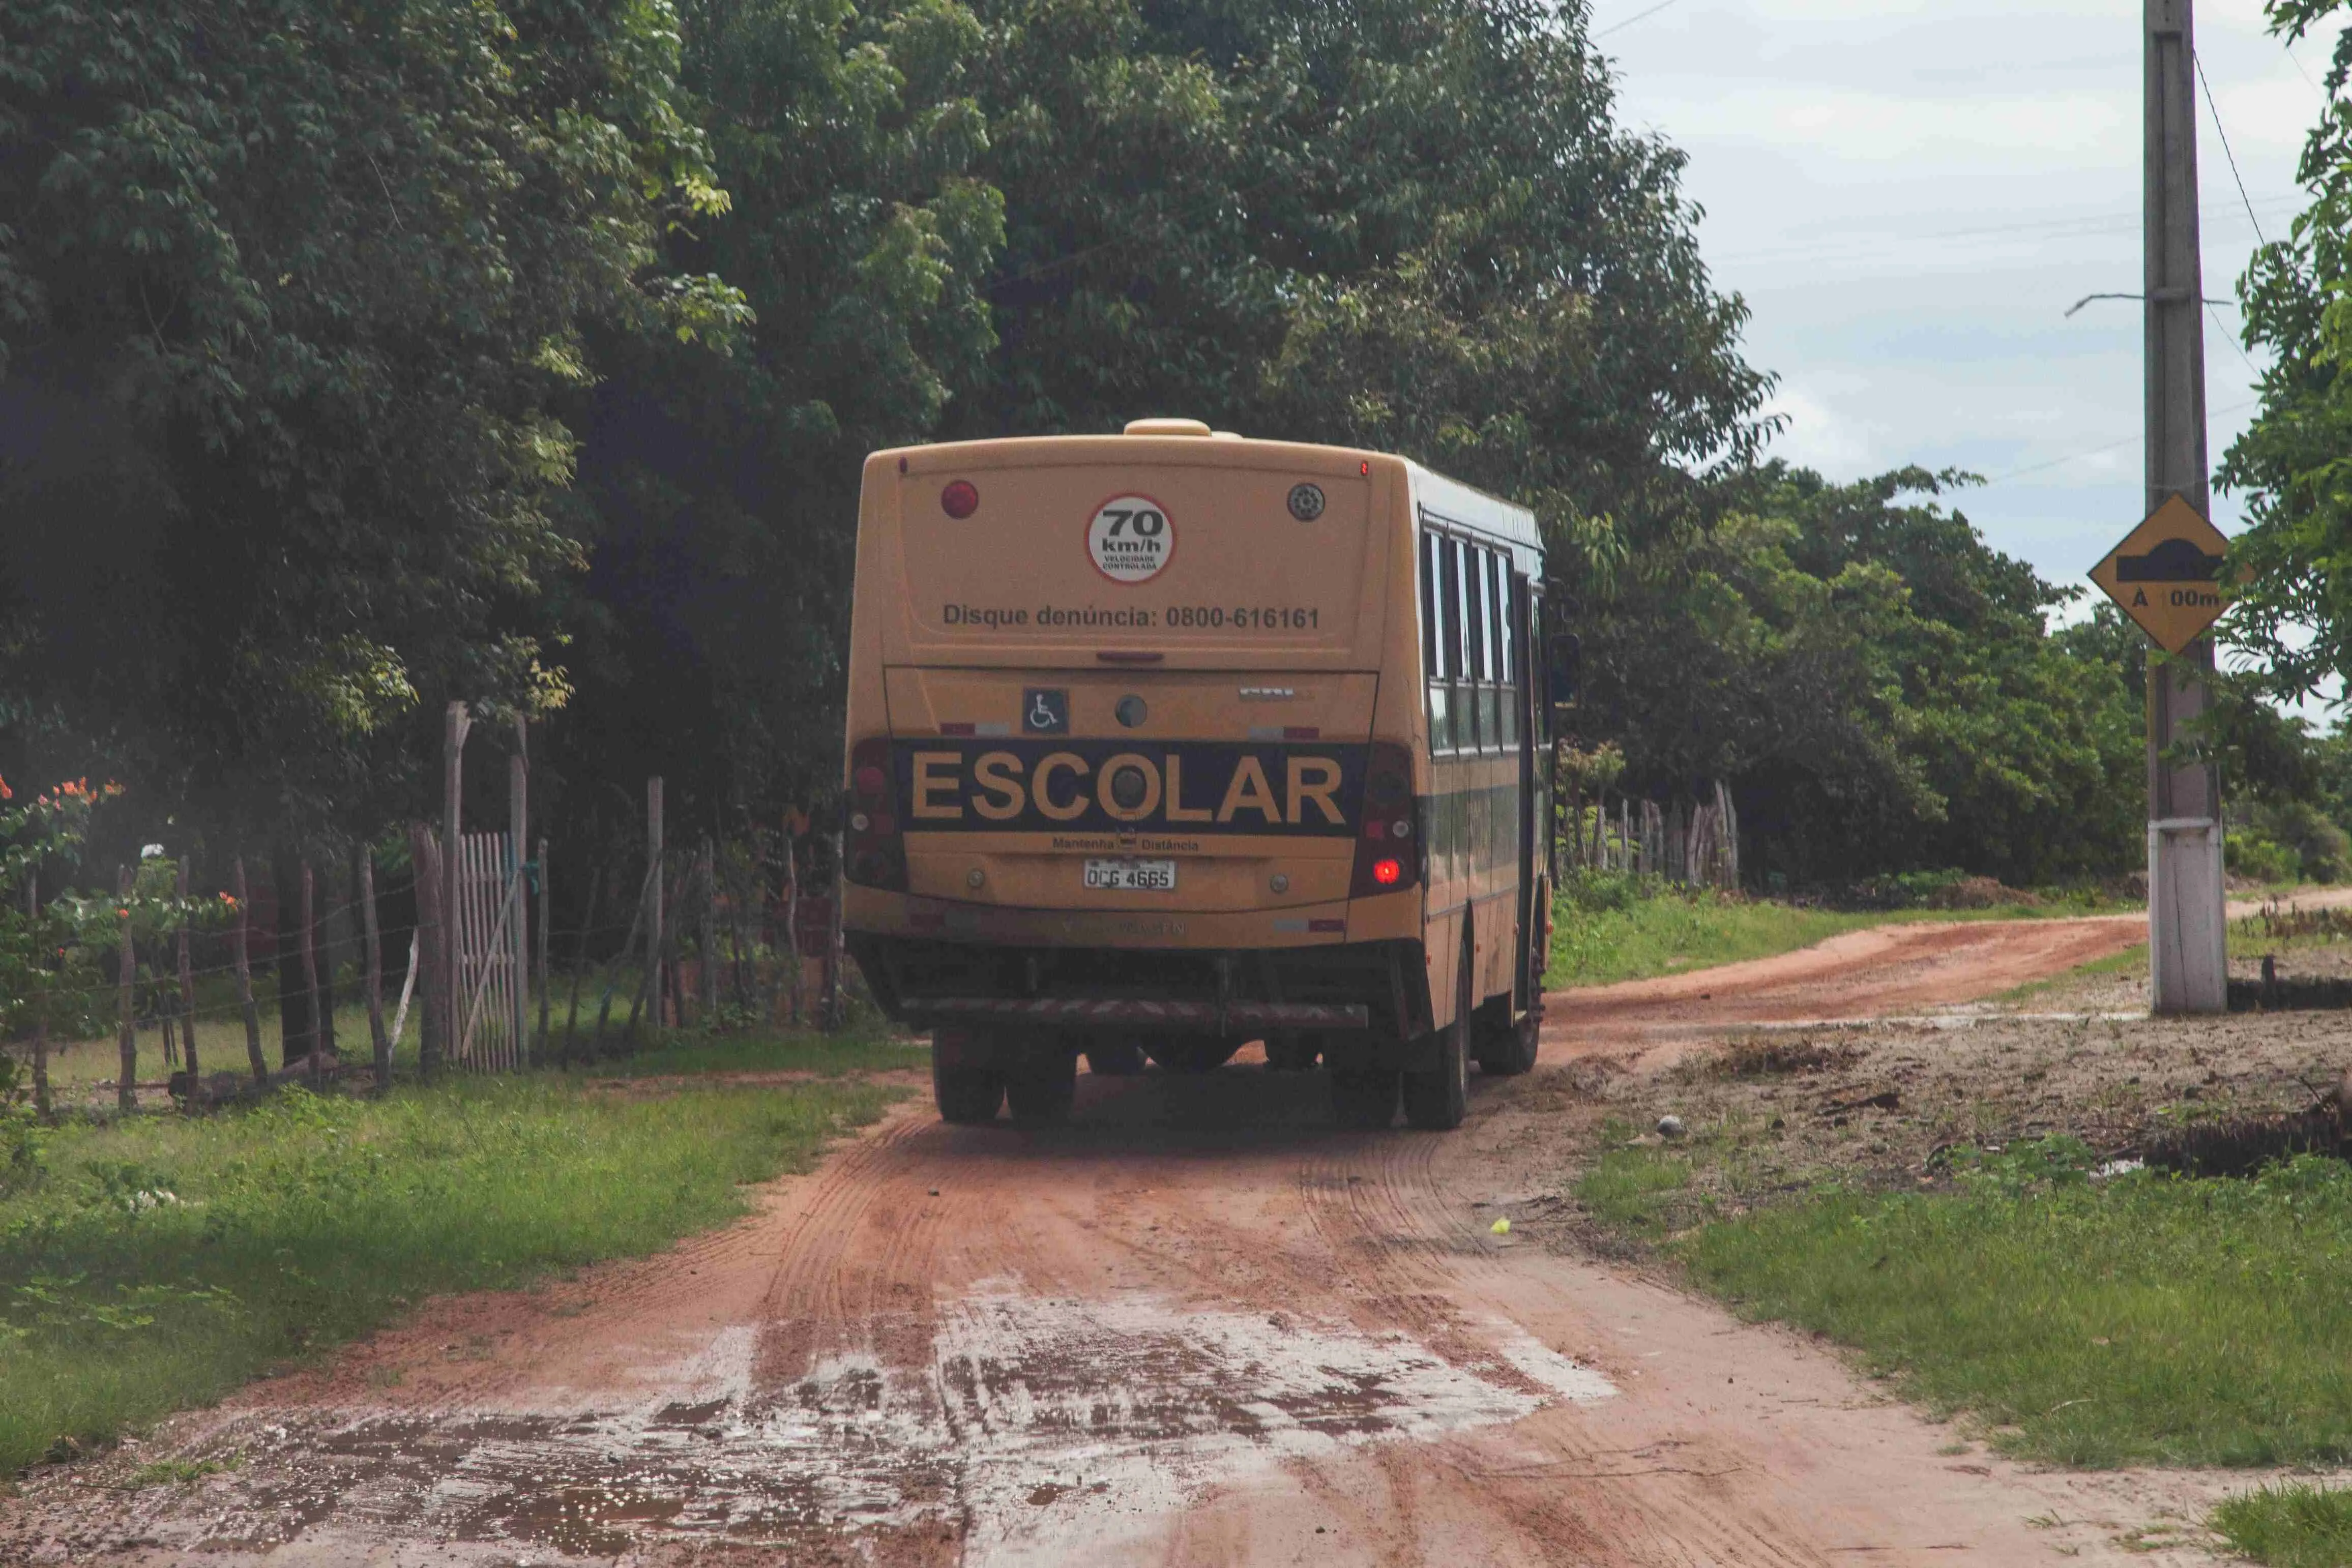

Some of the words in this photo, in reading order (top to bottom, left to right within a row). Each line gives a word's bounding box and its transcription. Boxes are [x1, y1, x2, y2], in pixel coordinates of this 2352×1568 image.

[1102, 510, 1163, 537] 70
[1102, 538, 1161, 553] km/h
[1102, 563, 1157, 571] CONTROLADA
[2132, 587, 2149, 607] A
[943, 604, 1028, 629] Disque
[1037, 604, 1157, 627] denúncia:
[1166, 606, 1319, 629] 0800-616161
[912, 751, 1346, 825] ESCOLAR
[1053, 837, 1114, 850] Mantenha
[1141, 838, 1199, 851] Distância
[1126, 870, 1169, 887] 4665
